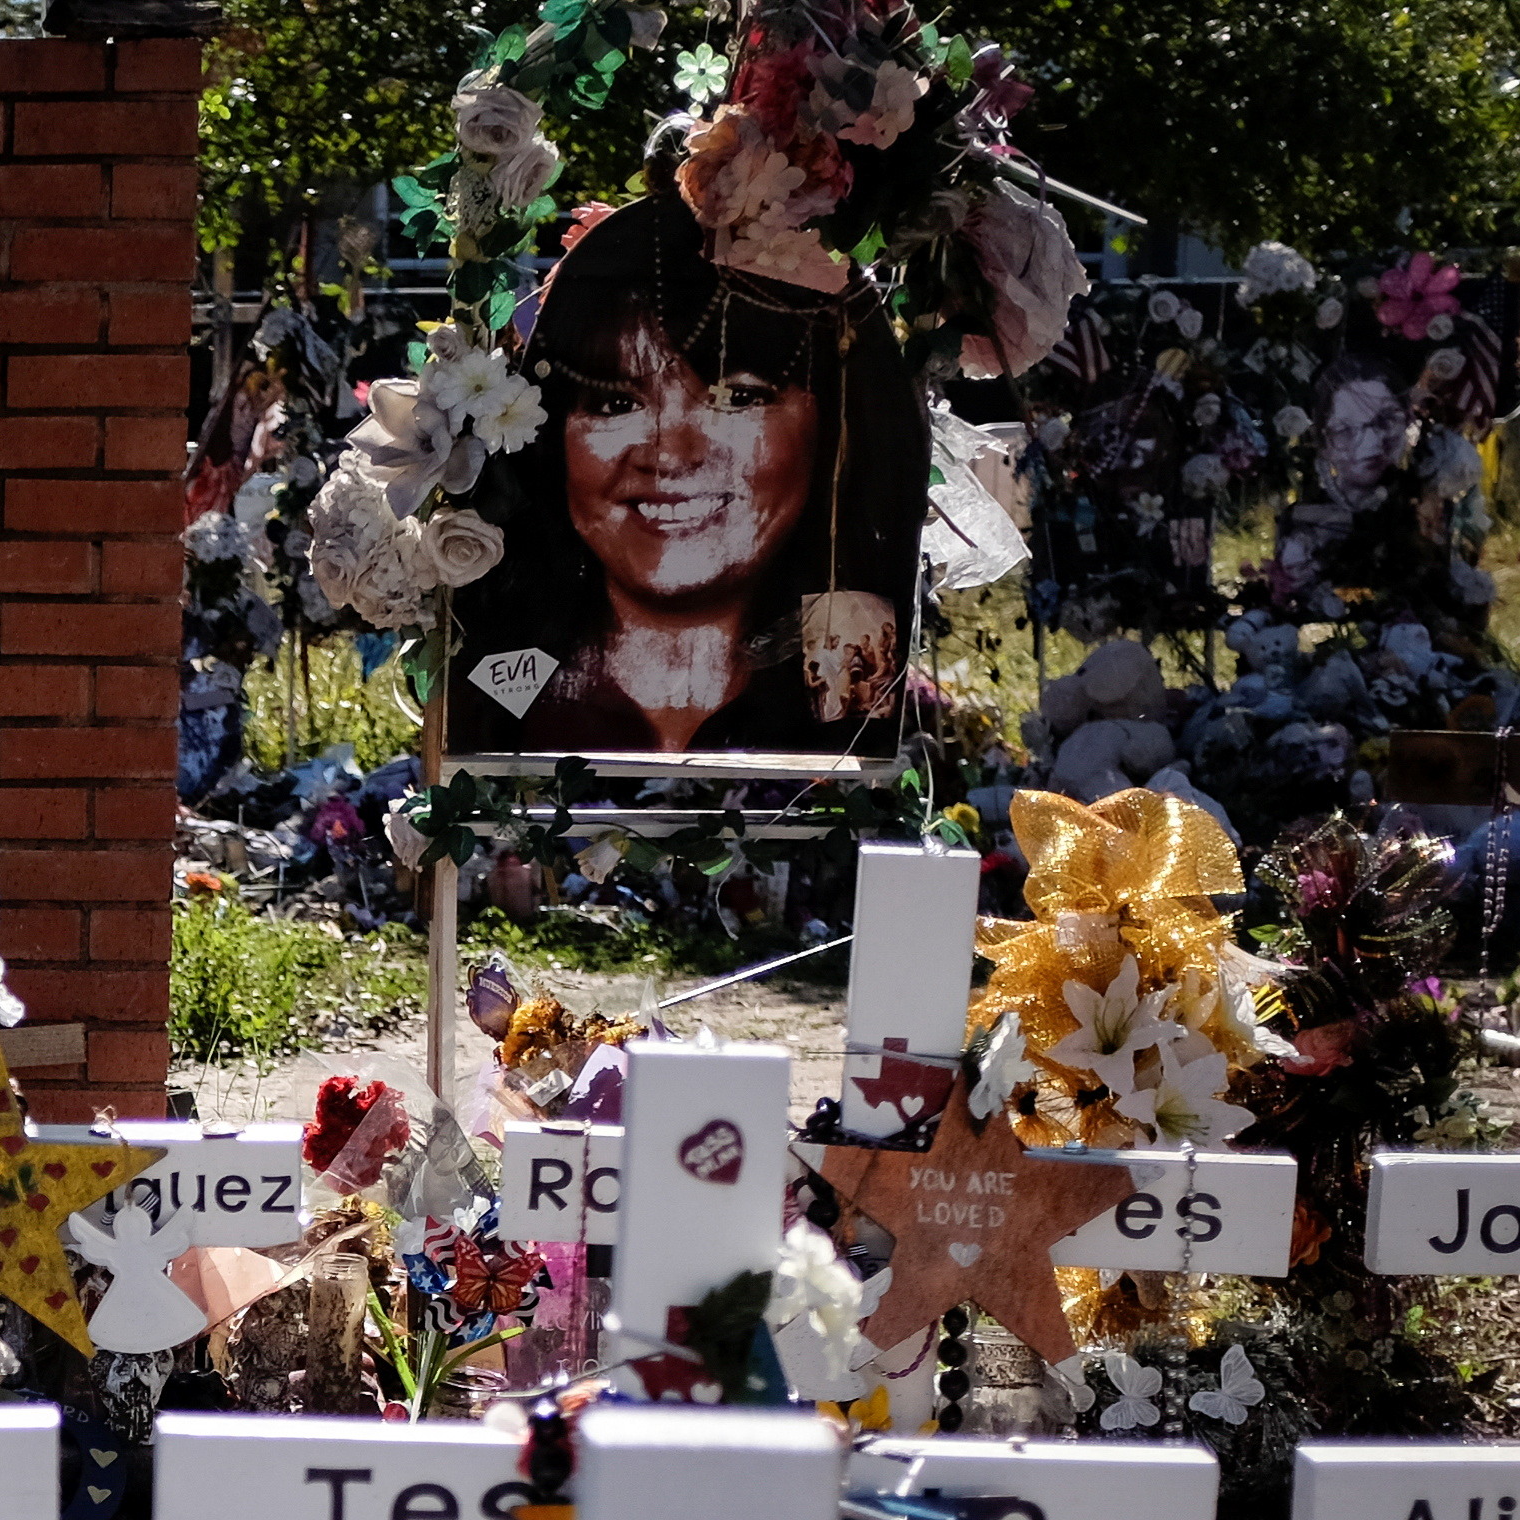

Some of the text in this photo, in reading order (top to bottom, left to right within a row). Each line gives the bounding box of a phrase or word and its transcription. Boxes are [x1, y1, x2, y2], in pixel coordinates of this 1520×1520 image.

[489, 653, 537, 686] EVA
[910, 1166, 1017, 1196] YOU ARE
[918, 1202, 1006, 1228] LOVED
[1067, 1191, 1223, 1244] es
[1428, 1188, 1520, 1255] Jo
